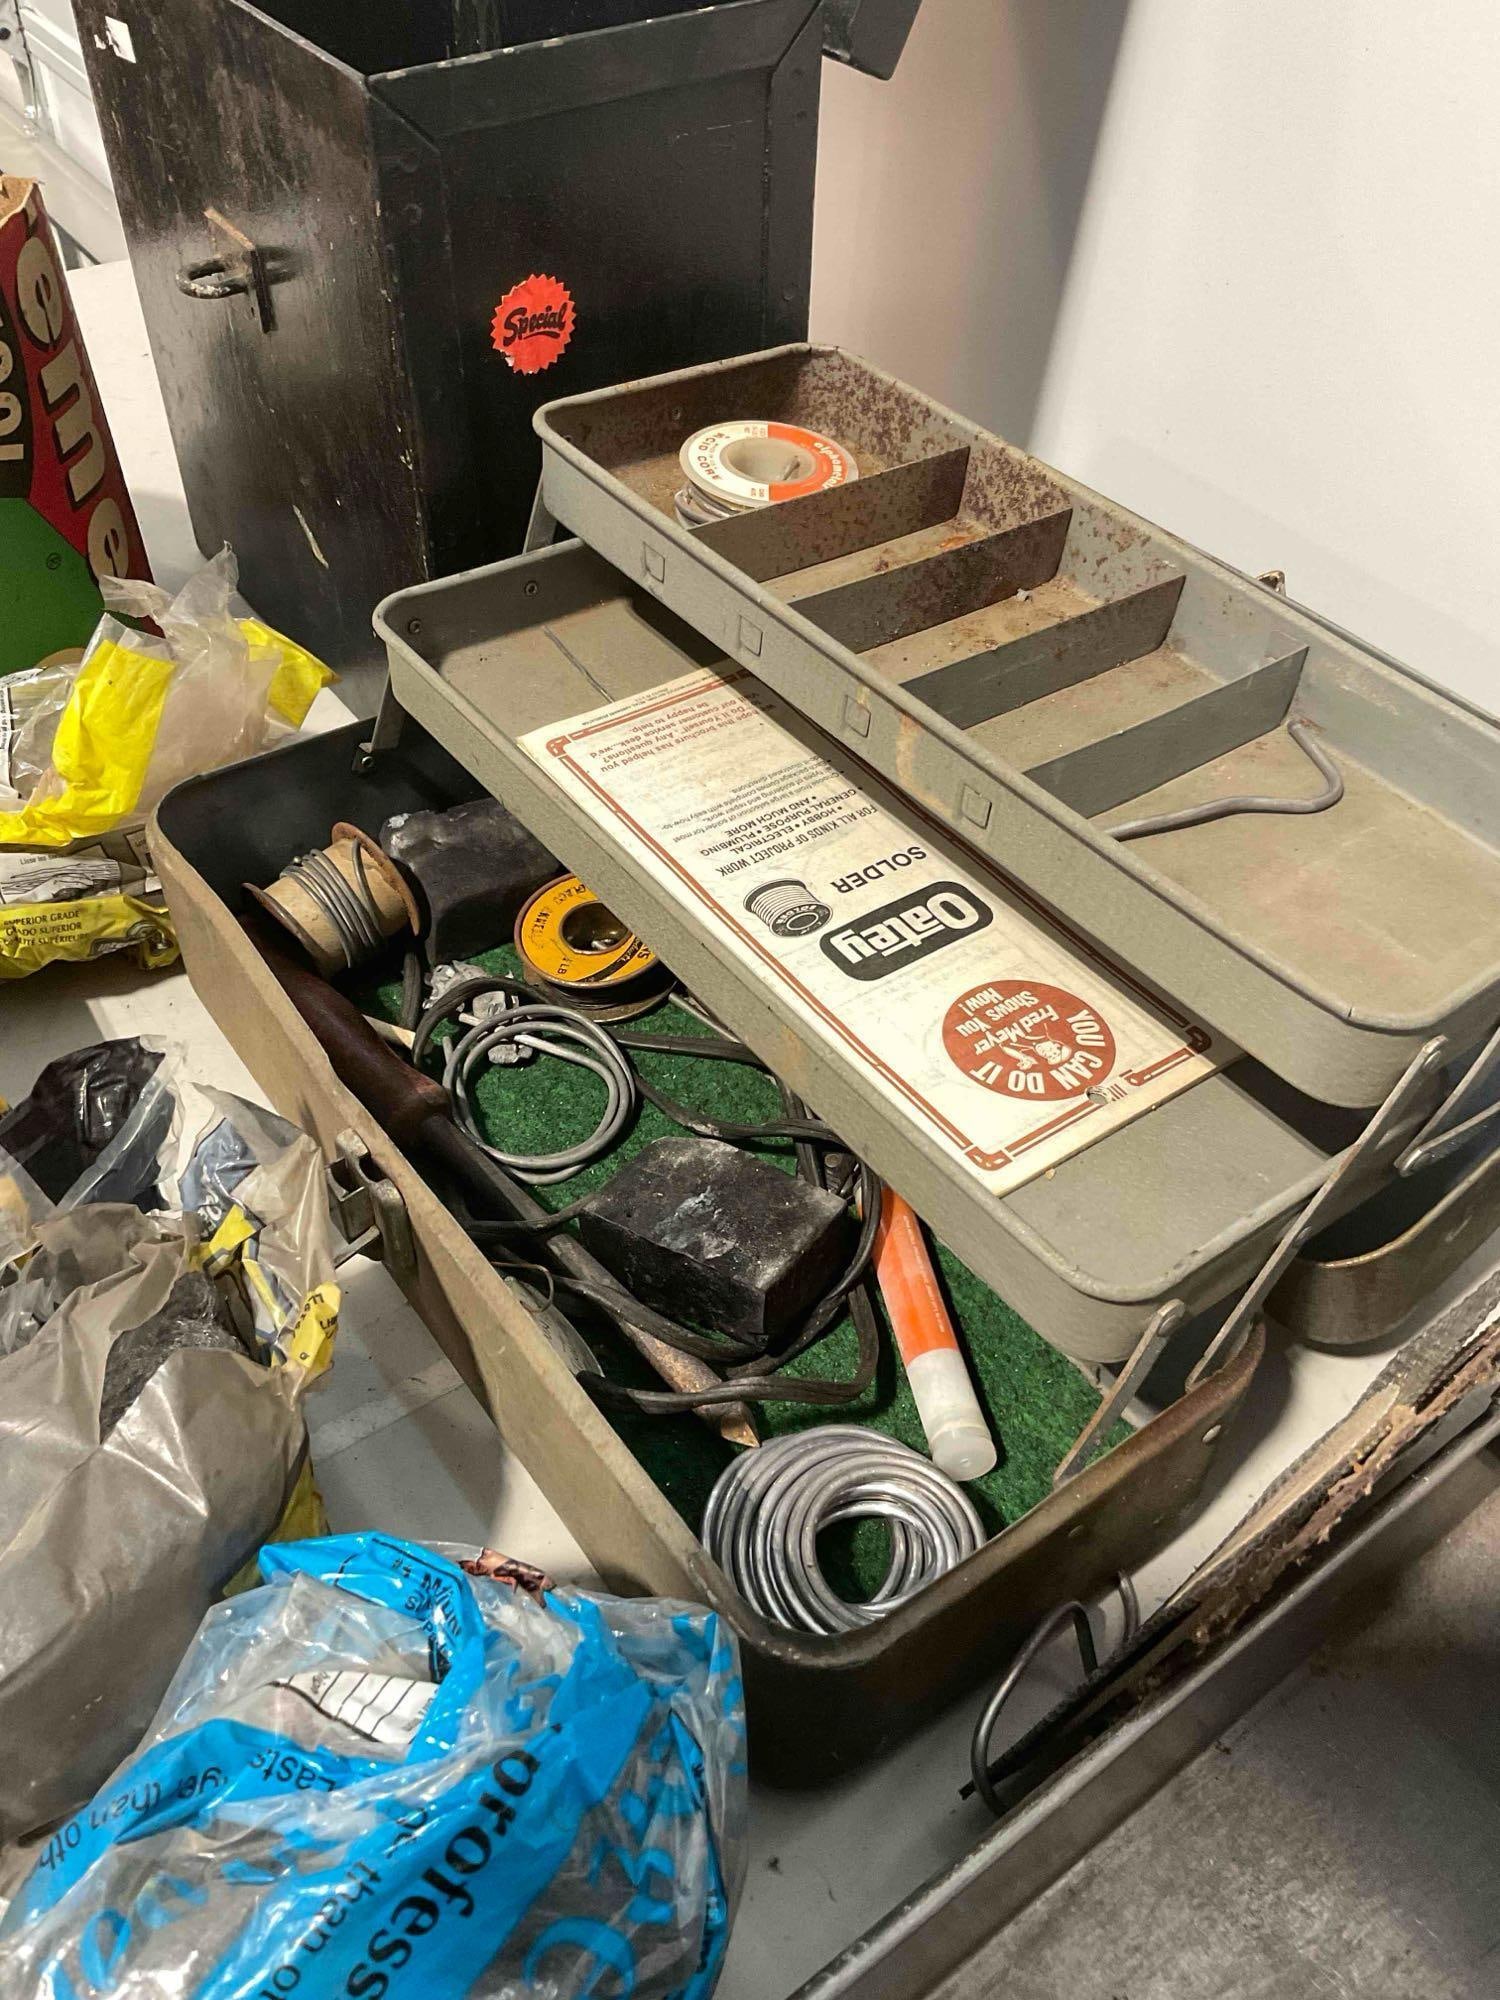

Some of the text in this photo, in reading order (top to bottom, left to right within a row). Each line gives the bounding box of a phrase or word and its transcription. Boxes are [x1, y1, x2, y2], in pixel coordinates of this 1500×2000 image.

[503, 302, 568, 346] Special
[16, 196, 128, 583] eme
[698, 432, 725, 451] ACID
[697, 456, 722, 480] CORE
[666, 704, 695, 722] happy
[678, 704, 720, 726] customer
[696, 700, 709, 710] be
[735, 707, 760, 723] hope
[643, 721, 677, 739] service
[674, 723, 717, 747] brochure
[716, 717, 735, 731] this
[654, 741, 674, 754] has
[655, 731, 674, 744] Any
[602, 738, 653, 765] questions?
[621, 747, 655, 767] helped
[600, 760, 620, 774] you
[700, 789, 857, 857] GENERAL PURPOSE PLUMBING
[704, 817, 728, 831] solder
[725, 797, 811, 838] AND MUCH MORE
[673, 831, 692, 843] most
[693, 827, 705, 836] for
[715, 805, 877, 877] FOR ALL KINDS OF PROJECT WORK
[730, 807, 836, 856] HOBBY ELECTRICAL
[830, 845, 927, 896] SOLDER
[50, 910, 81, 922] GRADE
[828, 889, 980, 967] Oatey
[956, 988, 1039, 1036] Shows You
[959, 987, 1003, 1018] How!
[972, 1003, 1059, 1055] Fred Meyer
[969, 1008, 1103, 1093] YOU CAN DO IT
[303, 1860, 382, 1953] than
